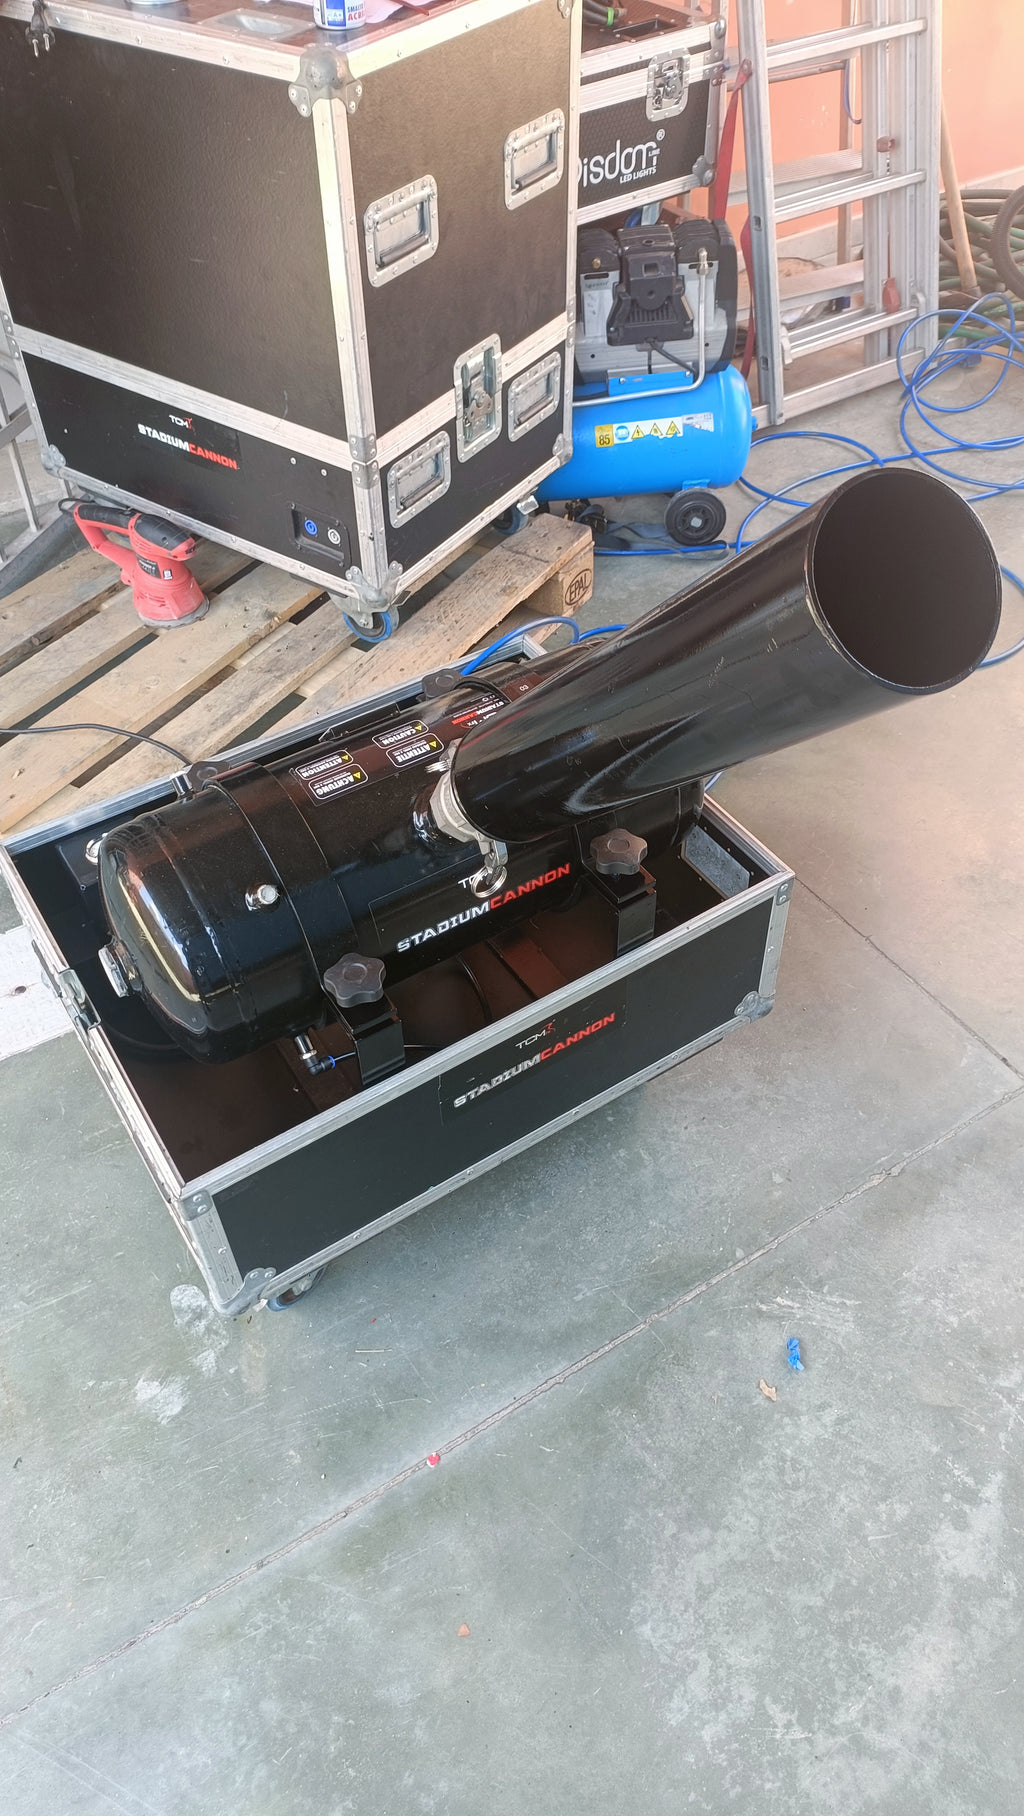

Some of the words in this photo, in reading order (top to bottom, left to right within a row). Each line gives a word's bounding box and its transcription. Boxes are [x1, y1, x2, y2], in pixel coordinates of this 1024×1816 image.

[619, 173, 633, 184] LED
[633, 165, 657, 180] LIGHTS
[598, 434, 611, 446] 85
[569, 572, 589, 603] EPAL
[381, 728, 417, 745] CAUTION
[395, 743, 431, 763] ATTENTIE
[301, 757, 343, 778] ATTENTION
[315, 774, 355, 796] ACHTUNG
